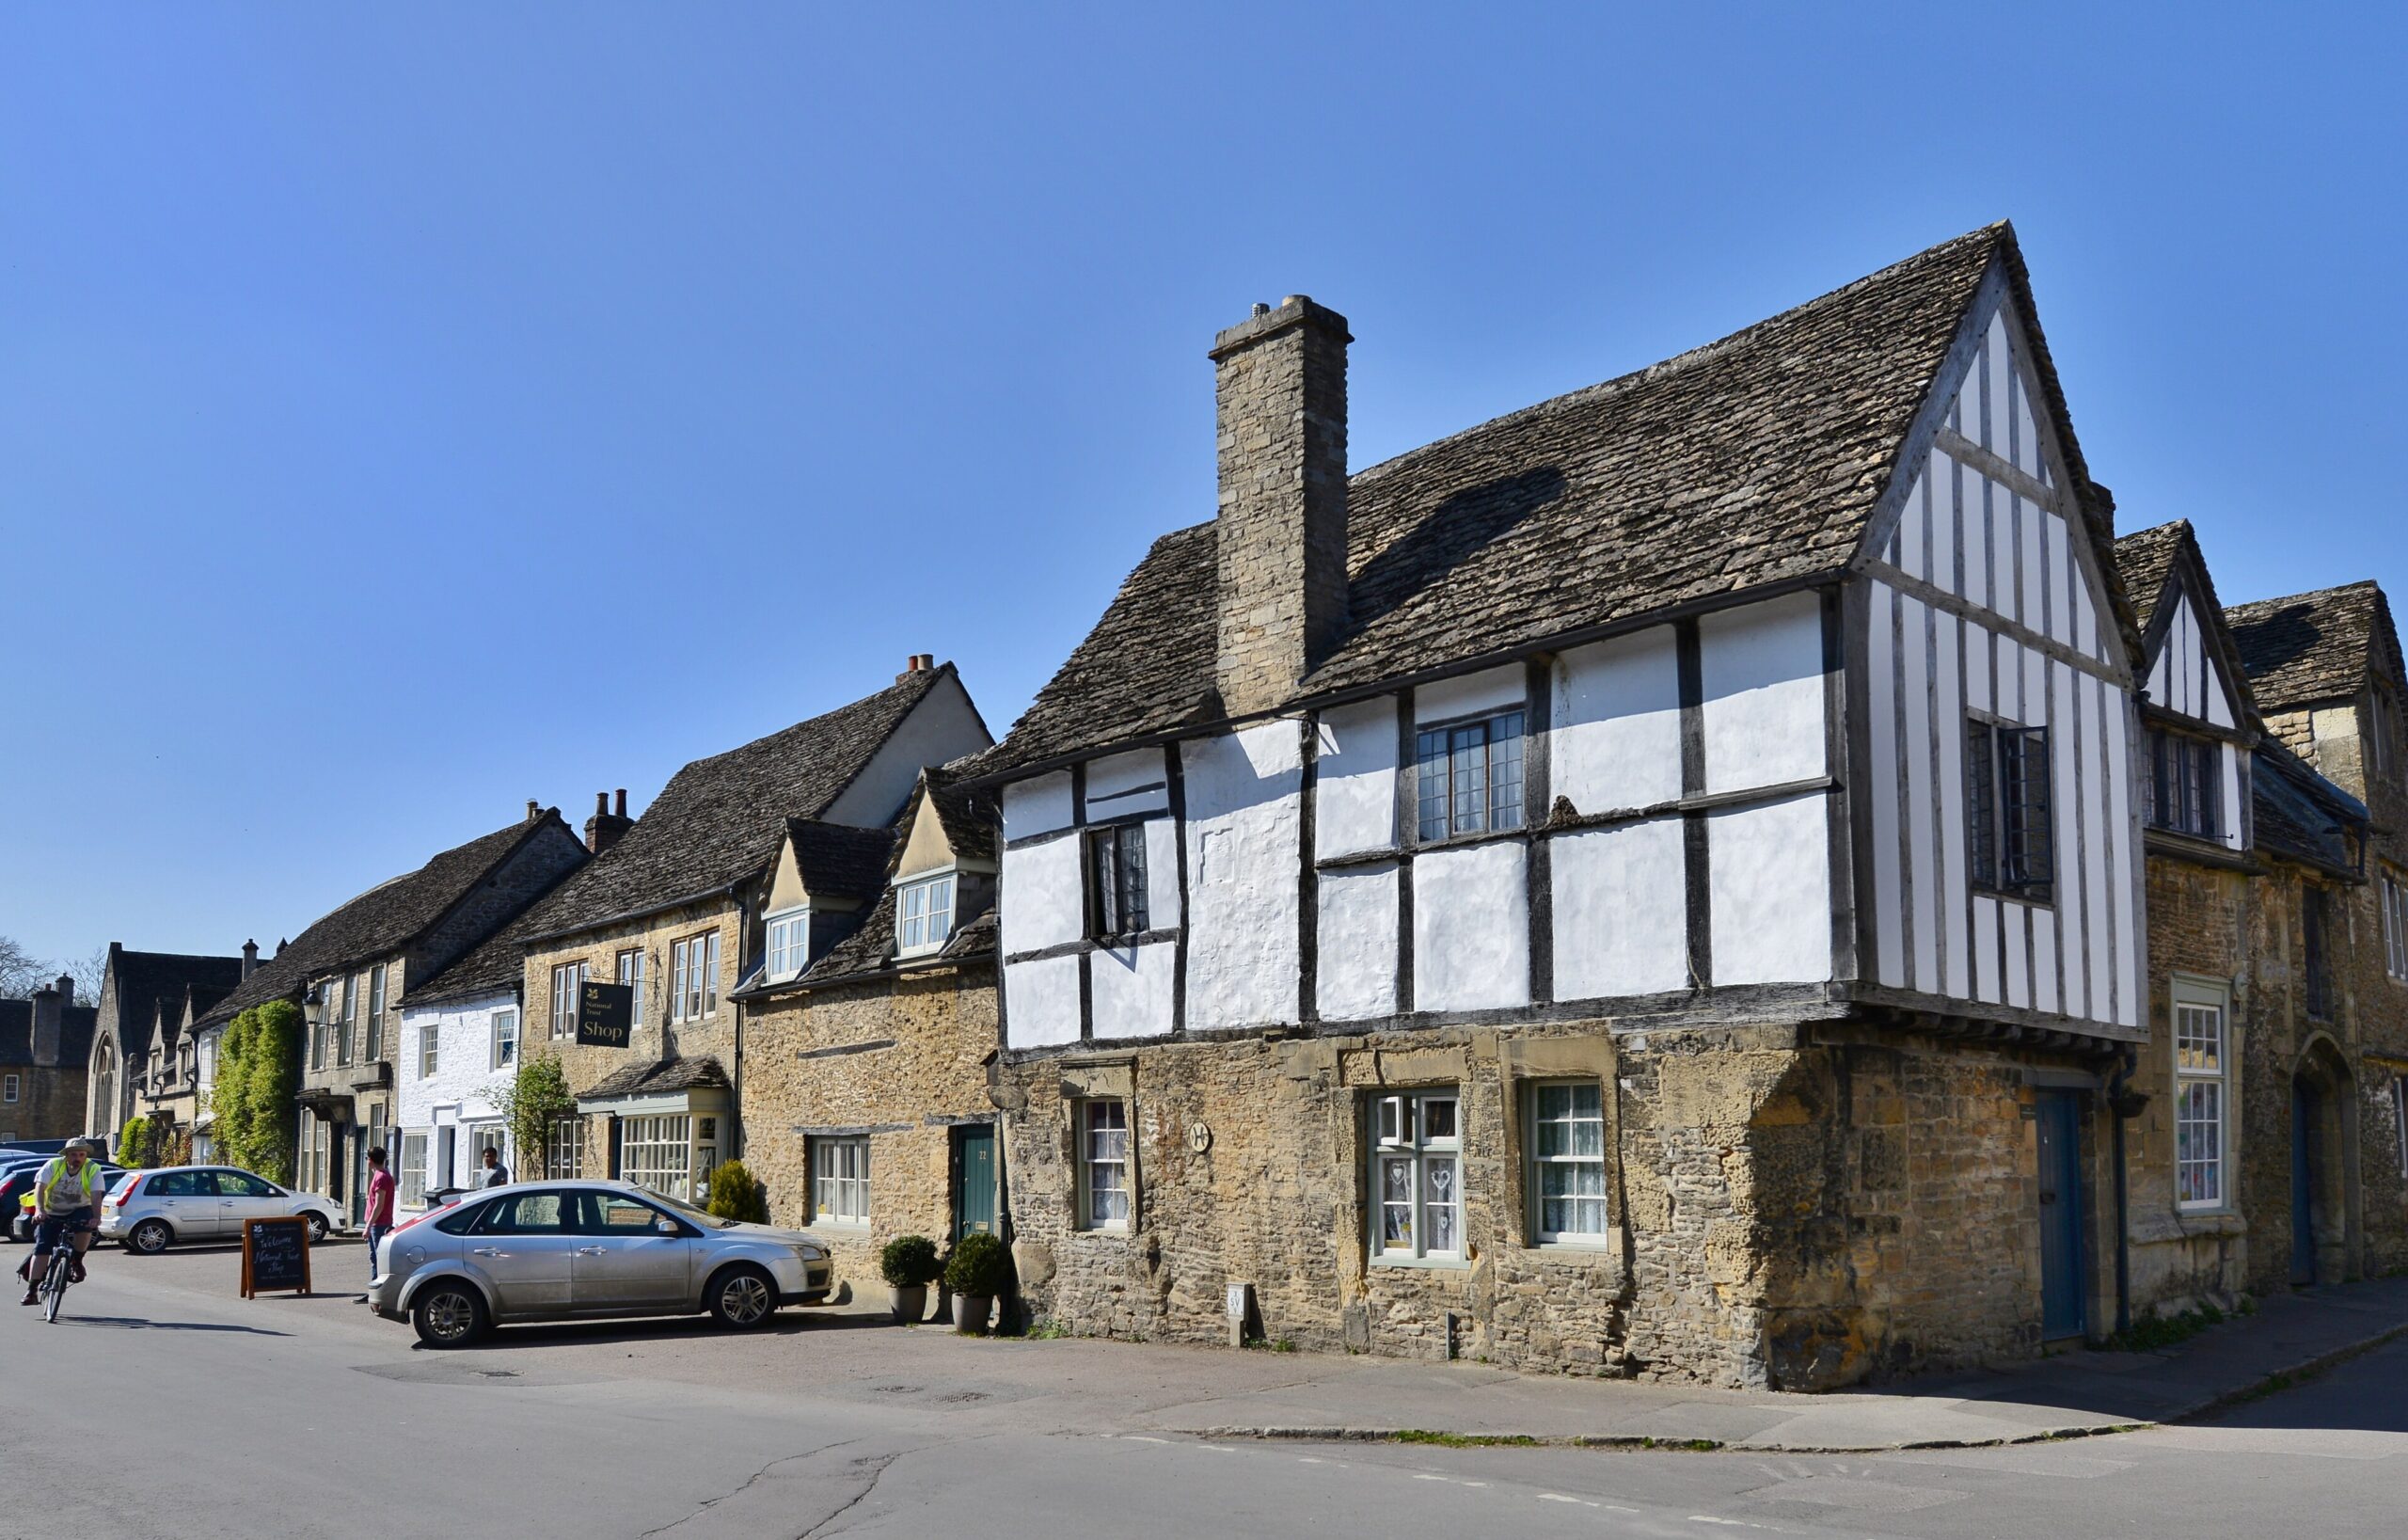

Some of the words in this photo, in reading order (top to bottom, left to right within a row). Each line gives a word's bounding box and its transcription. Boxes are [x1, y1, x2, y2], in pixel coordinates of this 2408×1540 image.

[585, 1001, 612, 1009] National
[583, 1021, 623, 1041] Shop
[253, 1249, 282, 1264] National
[268, 1261, 285, 1275] Shop
[1229, 1297, 1241, 1308] SV
